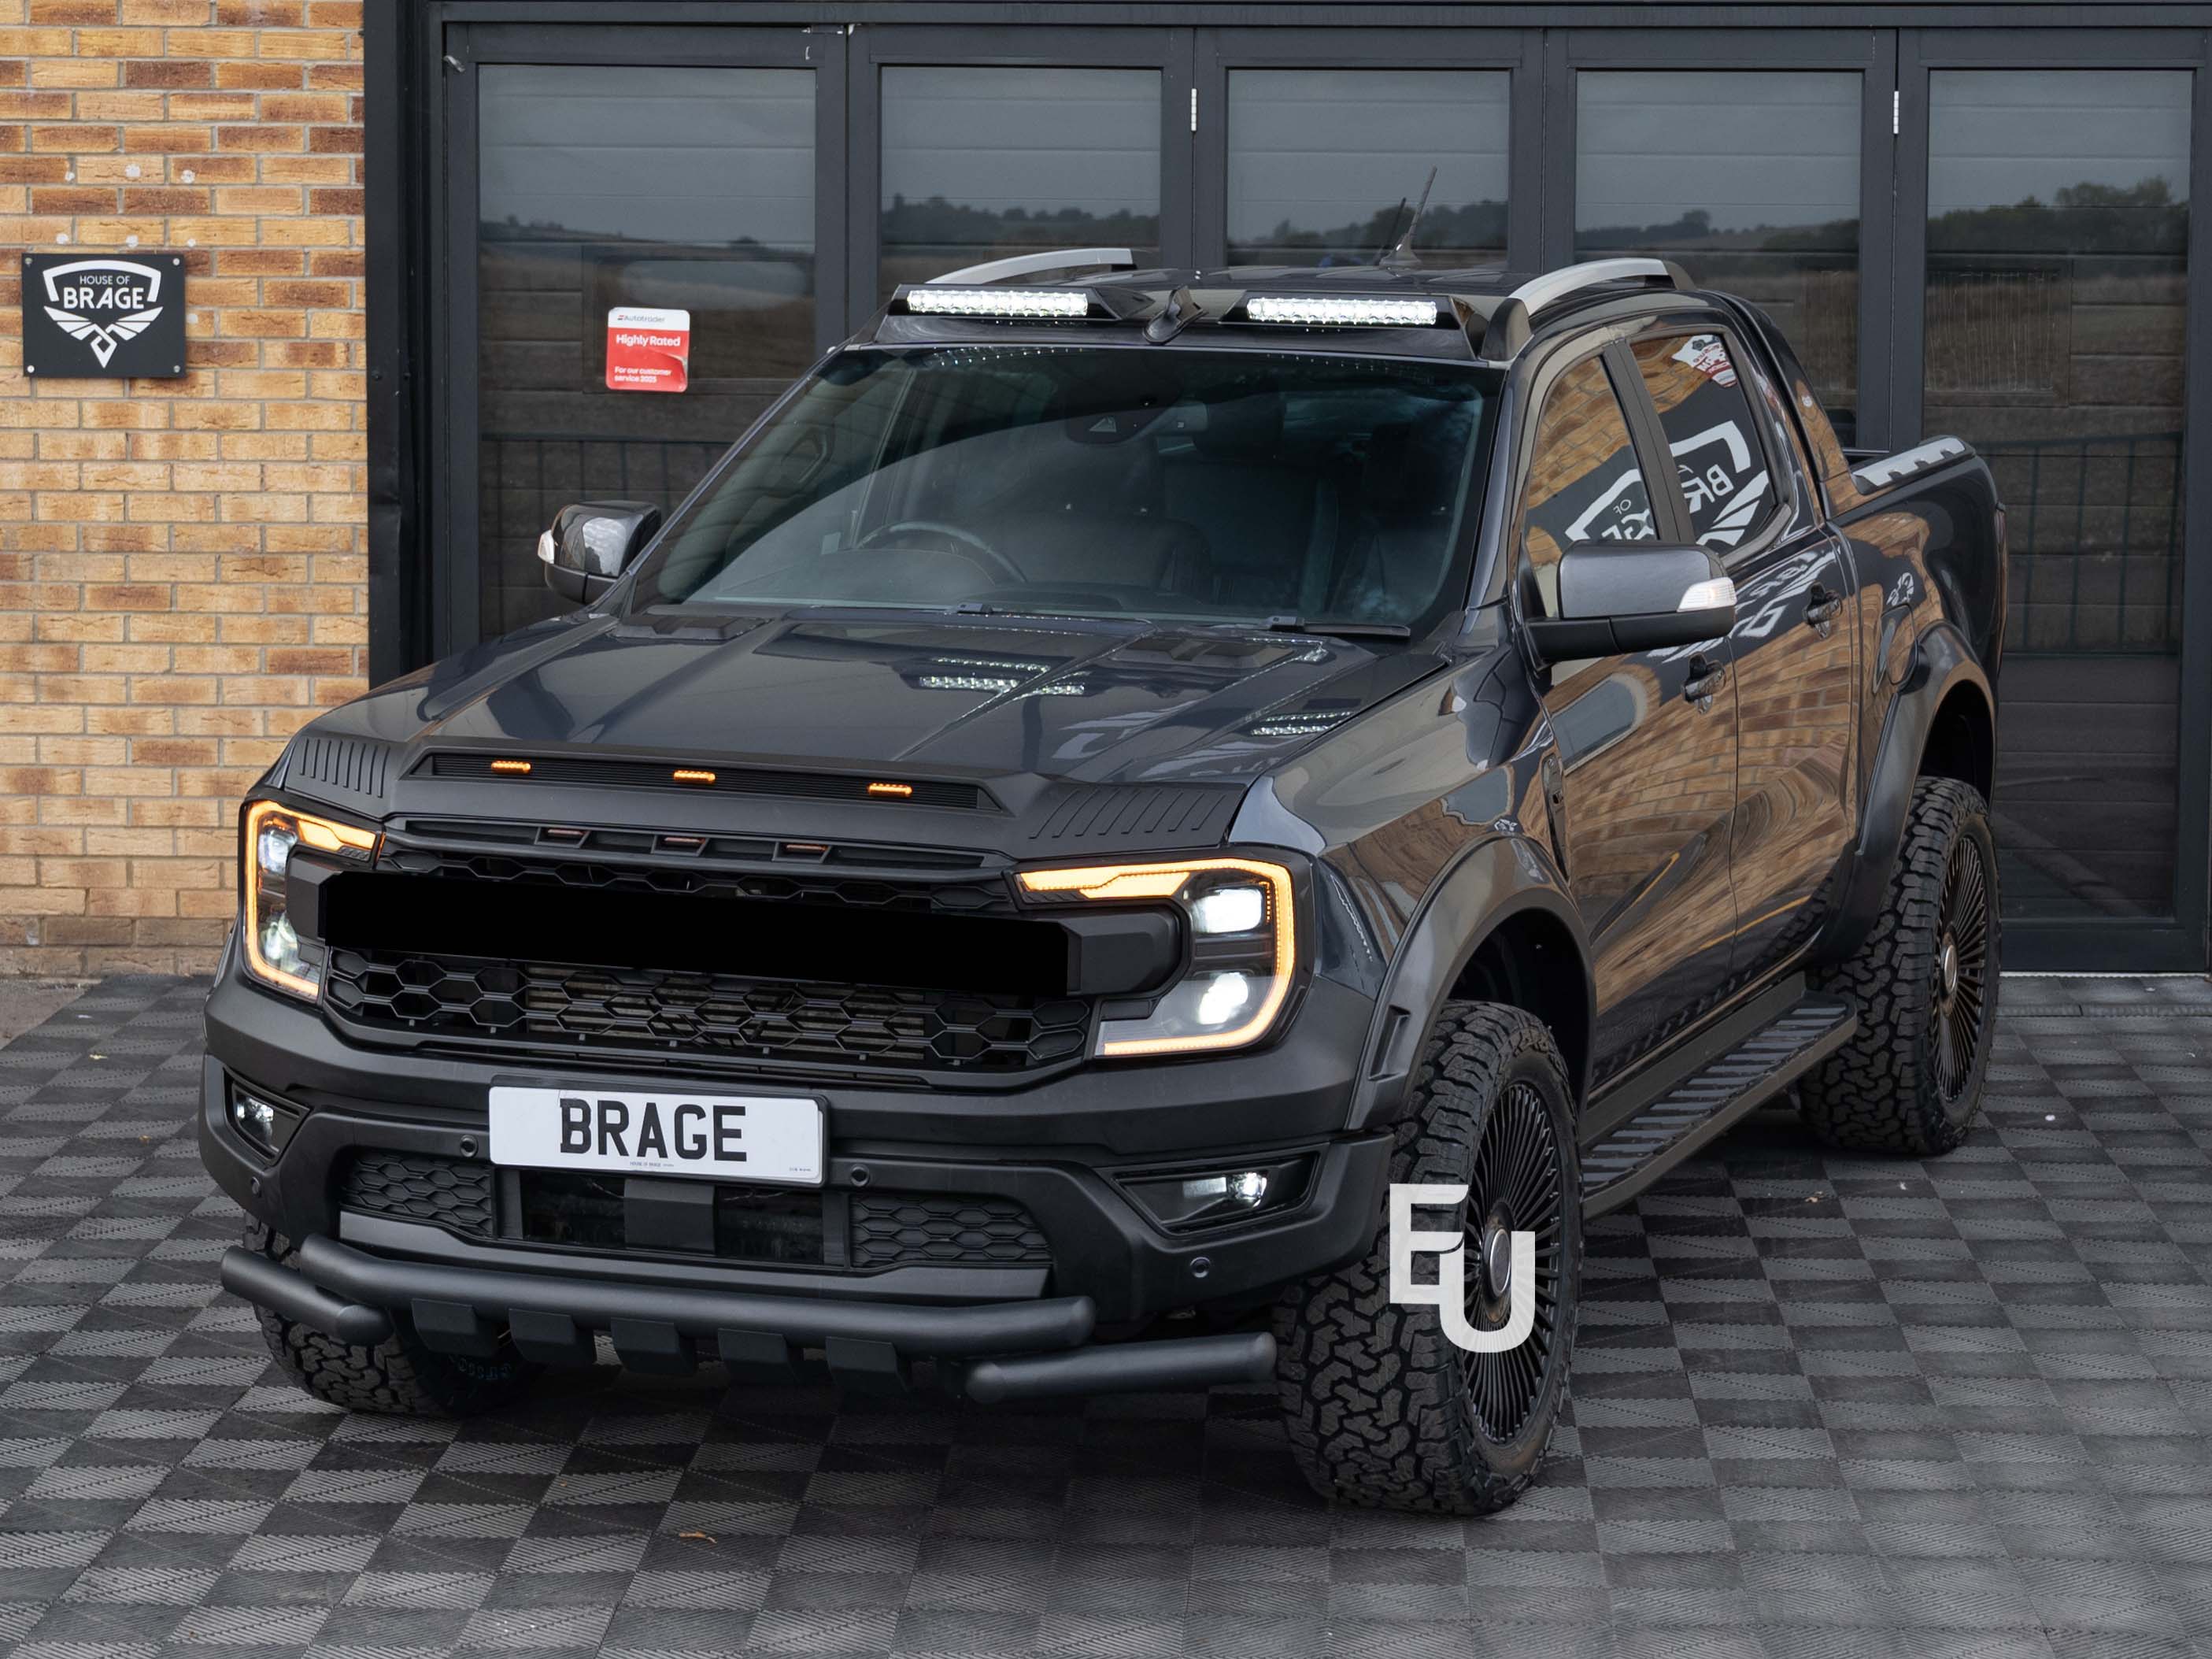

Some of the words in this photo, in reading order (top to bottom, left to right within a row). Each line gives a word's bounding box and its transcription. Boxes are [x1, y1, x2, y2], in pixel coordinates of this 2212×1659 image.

[80, 276, 113, 285] HOUSE
[117, 276, 130, 285] OF
[63, 287, 144, 309] BRAGE
[616, 334, 649, 346] Highly
[649, 336, 680, 346] Rated
[559, 1098, 747, 1162] BRAGE
